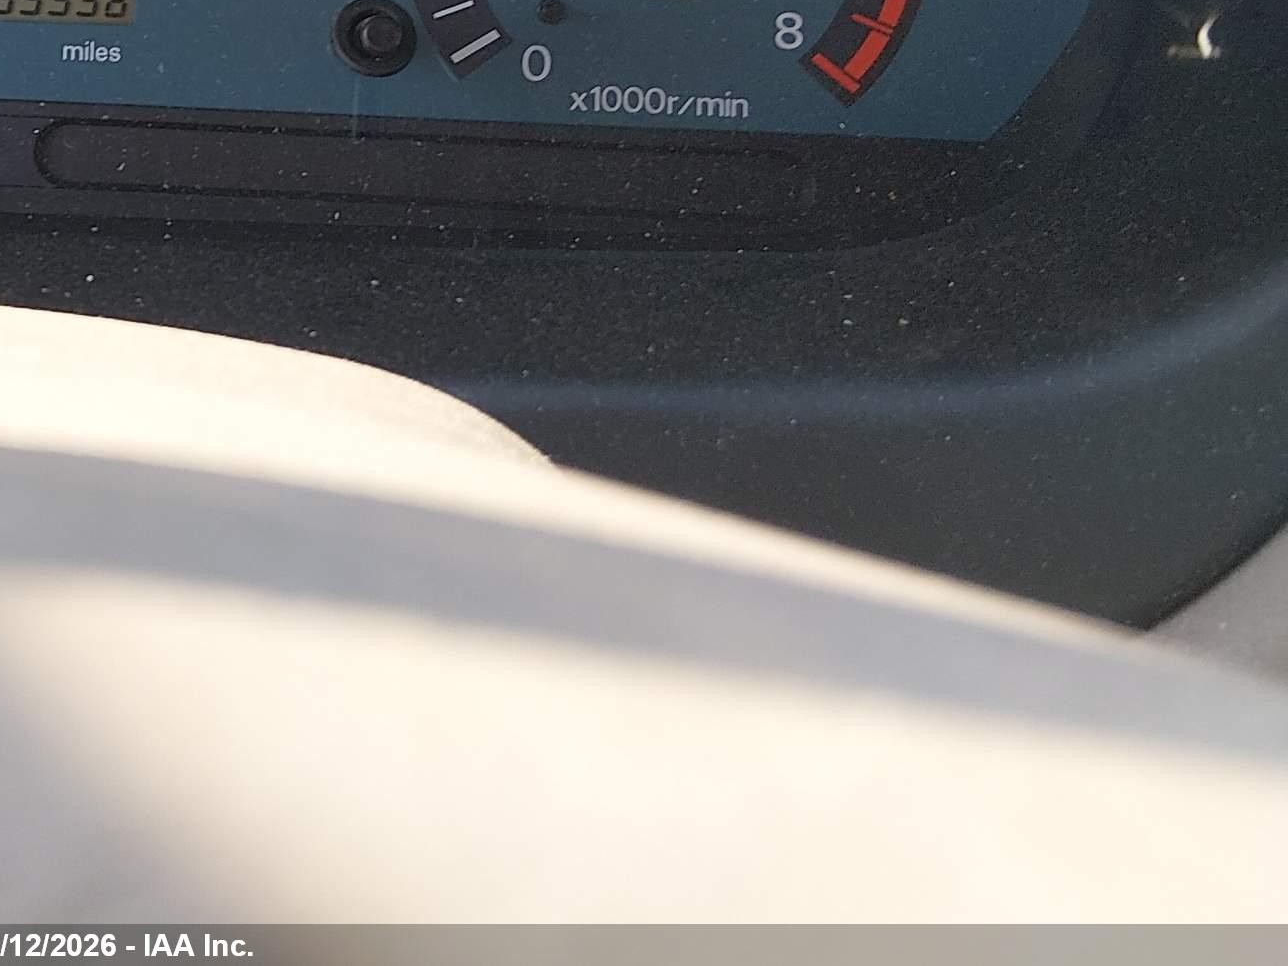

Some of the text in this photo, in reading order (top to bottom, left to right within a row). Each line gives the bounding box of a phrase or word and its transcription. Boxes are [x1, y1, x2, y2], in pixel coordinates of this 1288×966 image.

[775, 13, 803, 49] 8
[63, 41, 120, 61] miles
[523, 45, 551, 81] 0
[570, 86, 748, 117] x1000r/min
